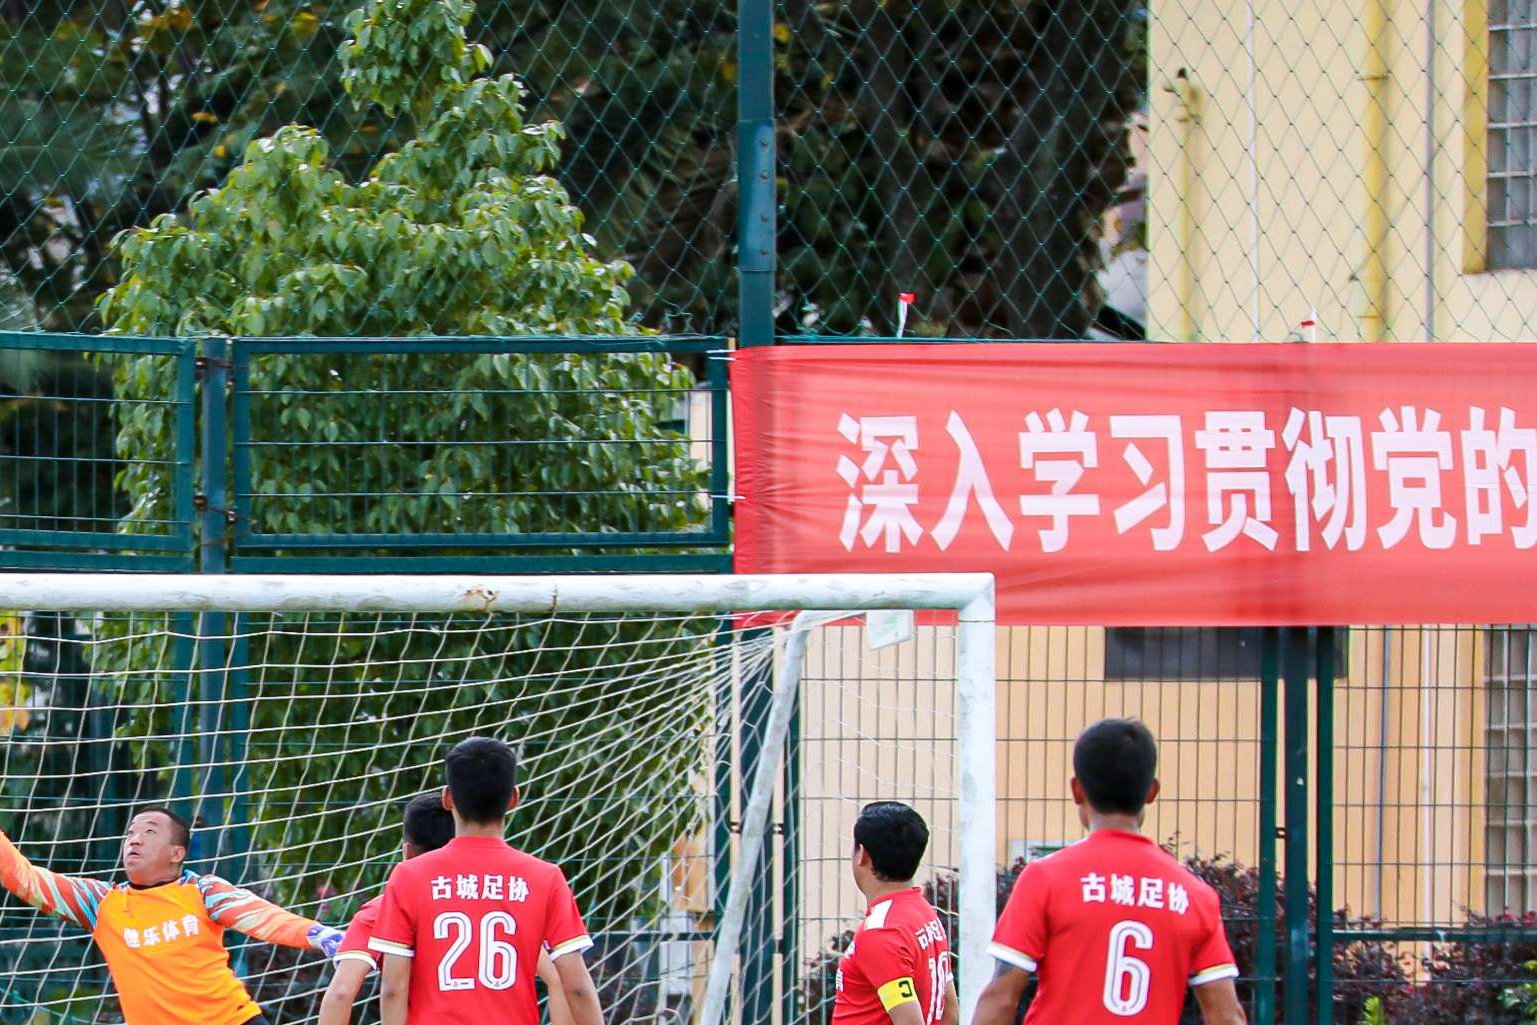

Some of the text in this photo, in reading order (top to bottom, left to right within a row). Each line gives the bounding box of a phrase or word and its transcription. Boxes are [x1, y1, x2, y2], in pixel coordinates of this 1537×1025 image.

[836, 405, 1537, 553] 深入学习贯彻党的
[431, 873, 530, 902] 古城足协
[1080, 872, 1190, 915] 古城足协
[123, 913, 200, 948] 乐体育
[433, 911, 518, 992] 26
[1103, 919, 1154, 1016] 6
